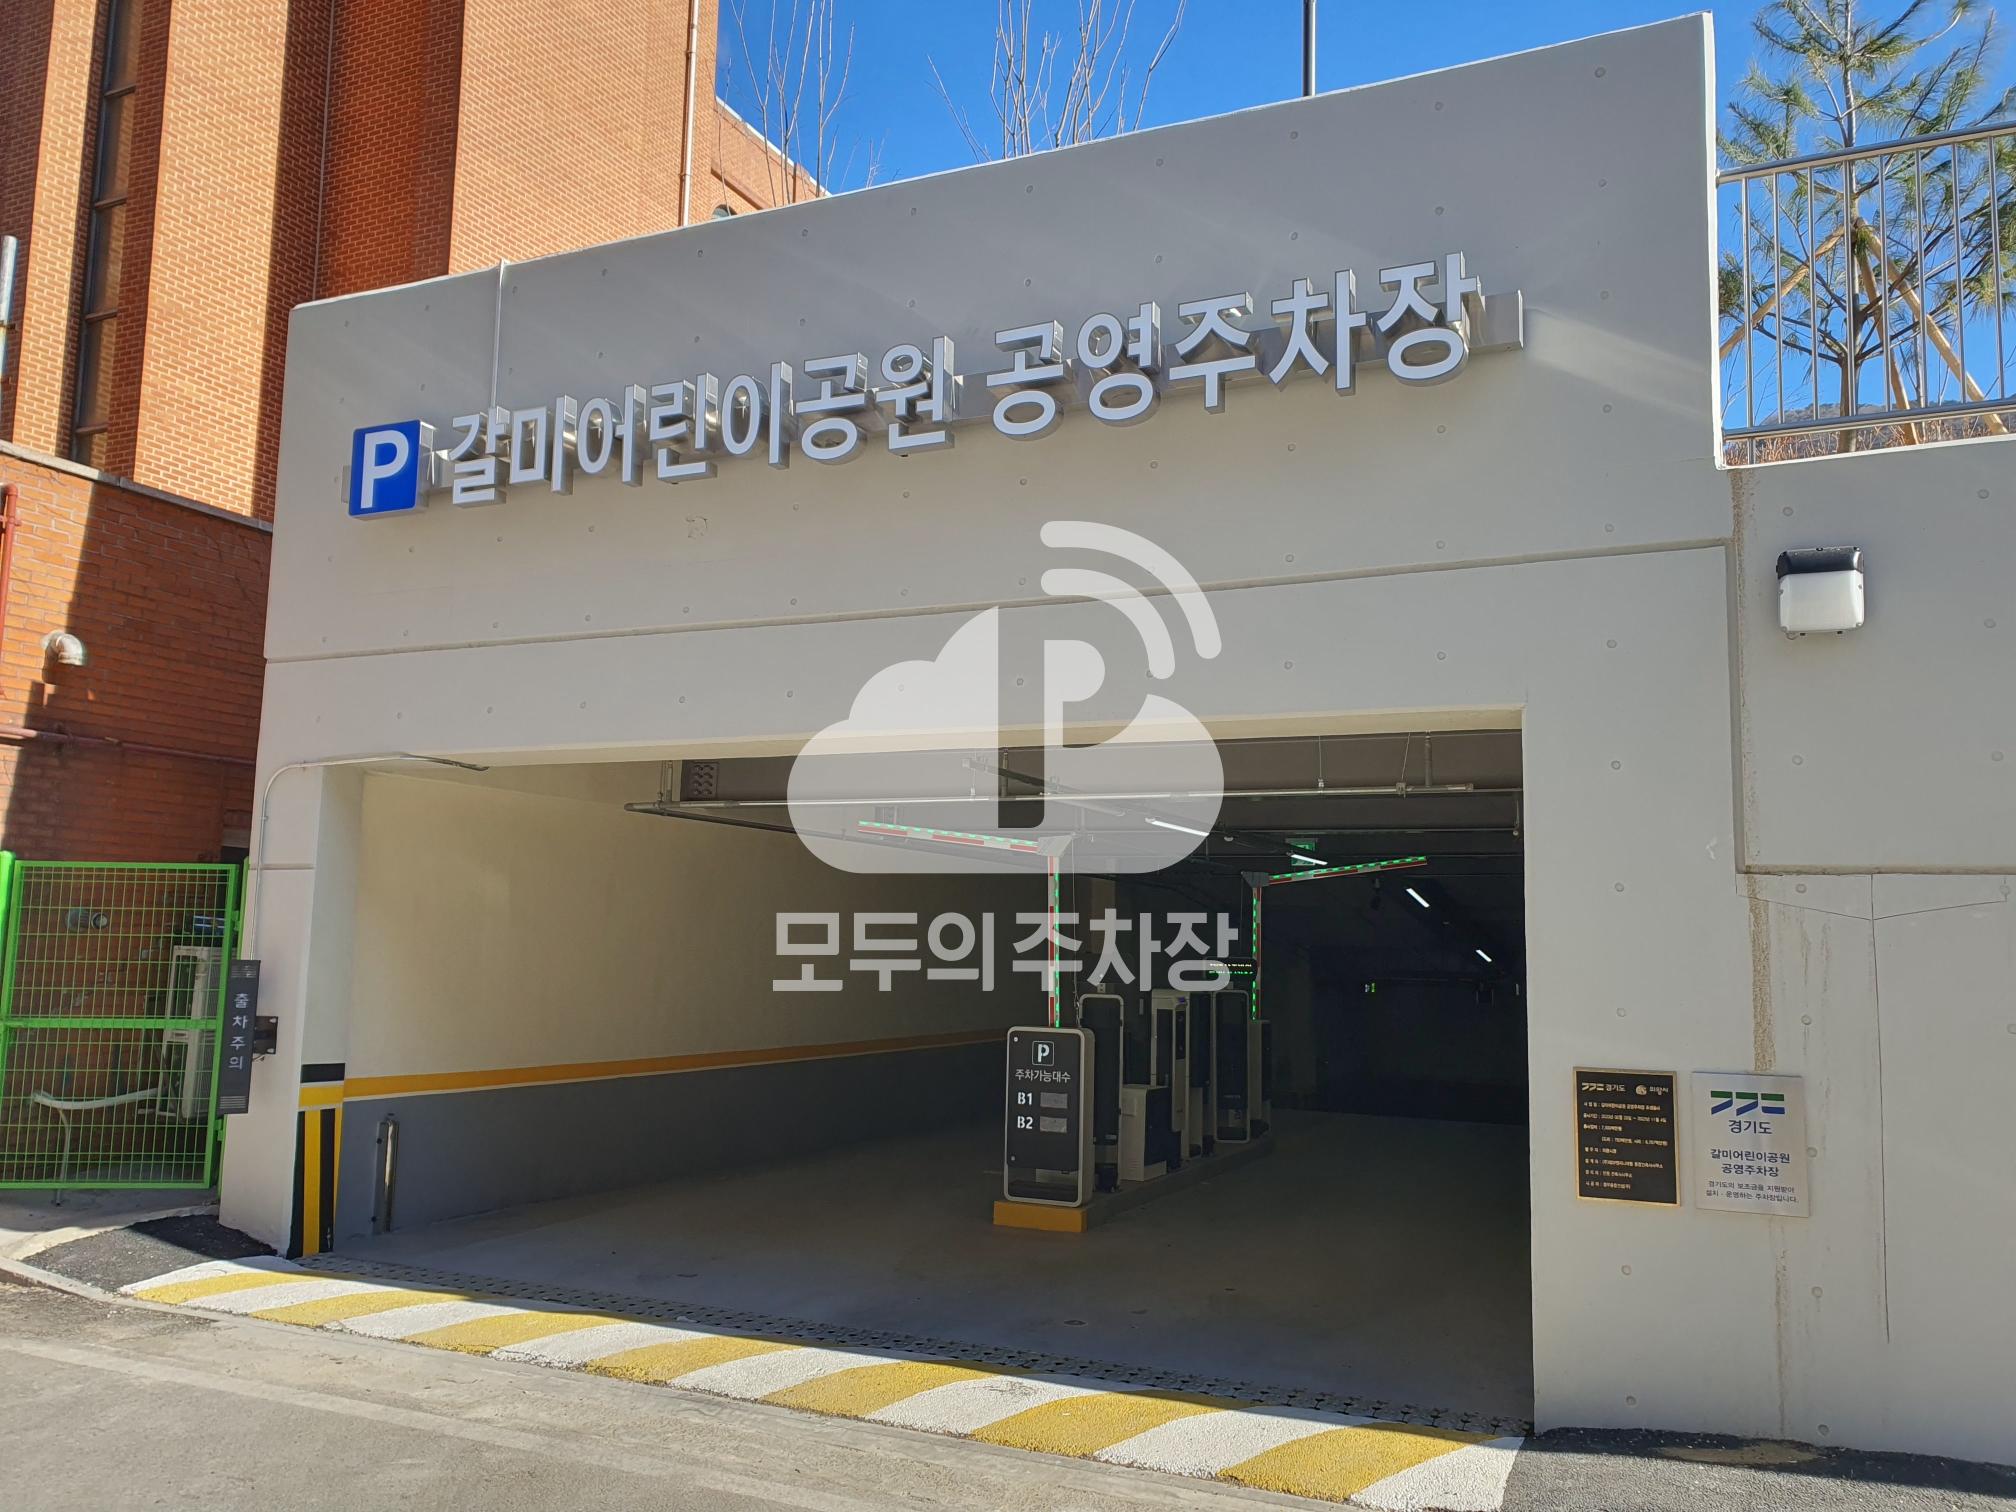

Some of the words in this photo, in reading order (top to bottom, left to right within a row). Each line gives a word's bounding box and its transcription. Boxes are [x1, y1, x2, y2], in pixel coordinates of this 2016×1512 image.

[449, 336, 954, 506] 갈미어린이공원
[986, 251, 1481, 439] 공영주차장
[360, 428, 409, 509] P
[228, 993, 249, 1069] 출차주의
[1037, 1043, 1050, 1063] P
[1015, 1069, 1071, 1083] 주차가능대수
[1606, 1083, 1626, 1092] 경기도
[1017, 1092, 1033, 1105] B1
[1017, 1116, 1033, 1129] B2
[1728, 1119, 1773, 1135] 경기도
[1710, 1148, 1791, 1164] 갈미어린이공원
[1721, 1163, 1780, 1178] 공영주차장
[1708, 1180, 1735, 1189] 경기도의
[1726, 1190, 1753, 1200] 운영하는
